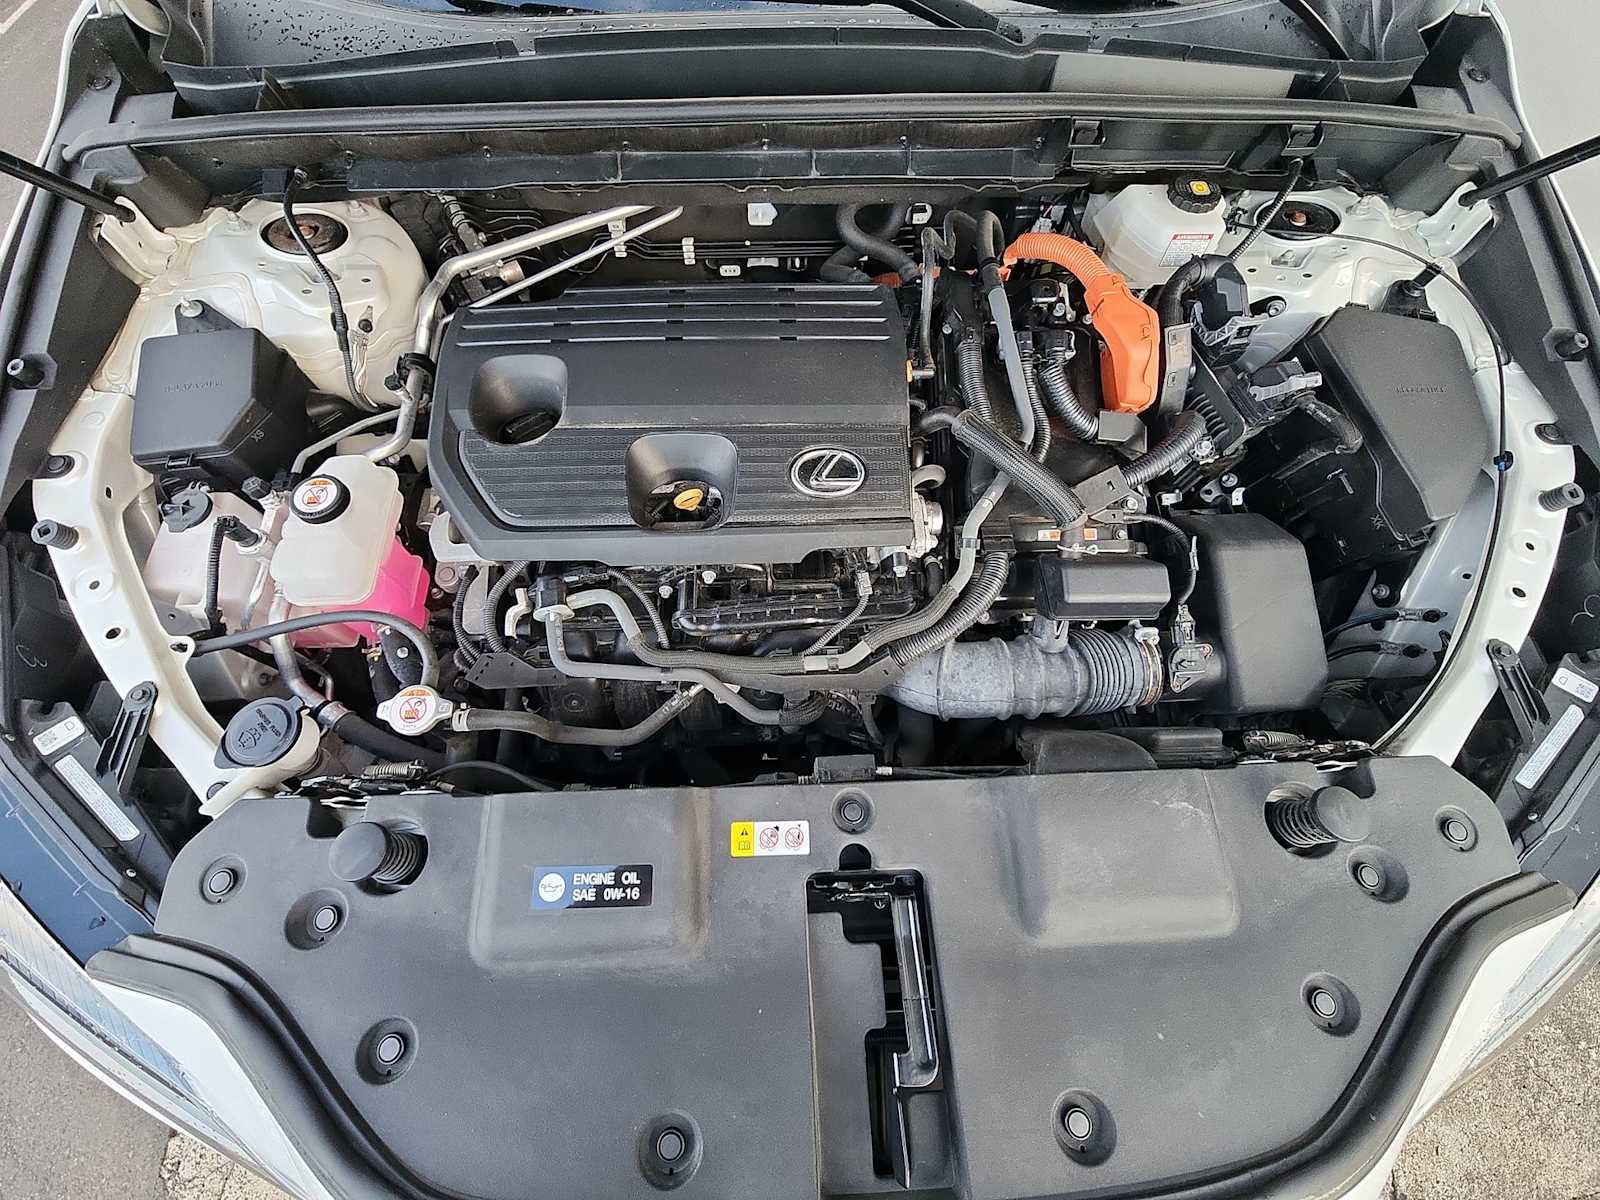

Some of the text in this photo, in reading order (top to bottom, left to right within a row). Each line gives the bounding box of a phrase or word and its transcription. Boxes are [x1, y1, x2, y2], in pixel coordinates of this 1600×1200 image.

[572, 871, 641, 886] ENGINE OIL
[571, 886, 641, 902] SAE 0W-16
